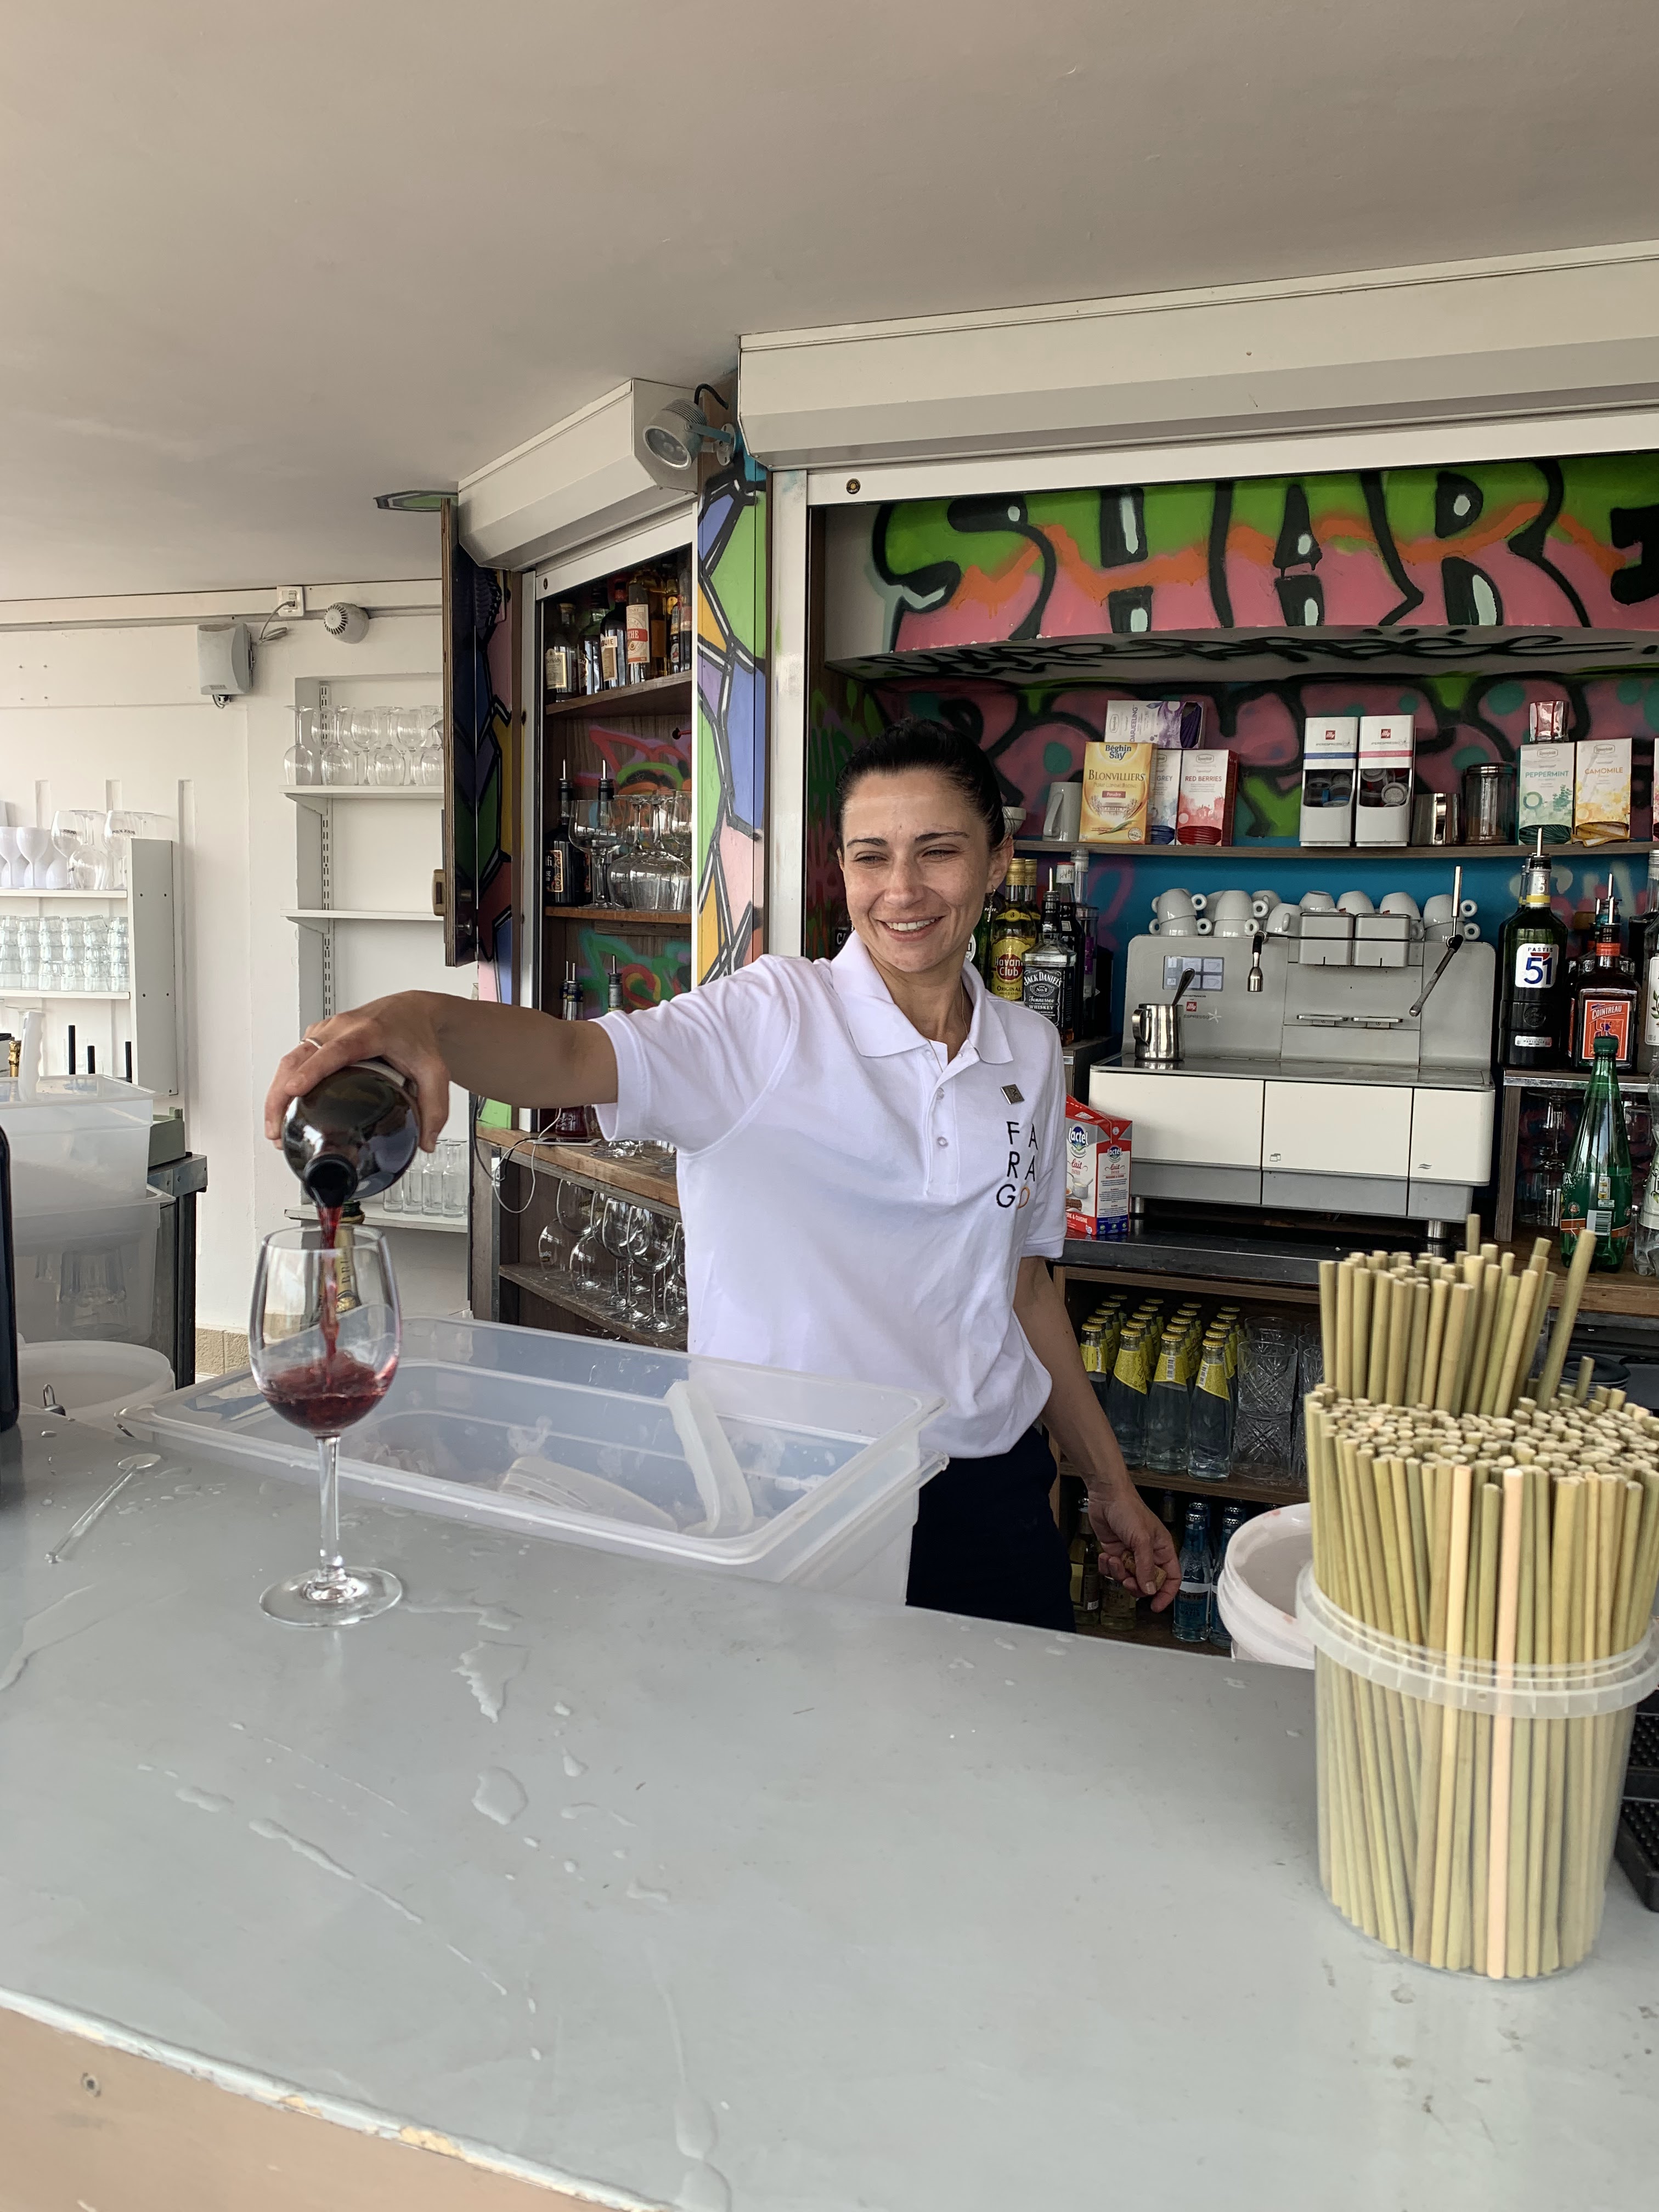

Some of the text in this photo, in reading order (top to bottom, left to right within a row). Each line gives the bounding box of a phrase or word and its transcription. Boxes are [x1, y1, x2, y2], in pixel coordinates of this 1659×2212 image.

[1130, 707, 1138, 742] DARJEELING
[1381, 730, 1391, 738] illy
[1105, 744, 1132, 753] Béghin
[1109, 752, 1126, 760] Say
[1088, 769, 1144, 781] BLONVILLIERS
[999, 967, 1019, 976] Club
[1523, 957, 1553, 985] 51
[1024, 972, 1063, 988] JACK DANIEL'S
[1187, 1003, 1197, 1011] illy
[1592, 1005, 1622, 1020] COINTREAU
[1068, 1126, 1089, 1147] lactel
[1107, 1147, 1123, 1156] lactel
[1071, 1158, 1082, 1169] lait
